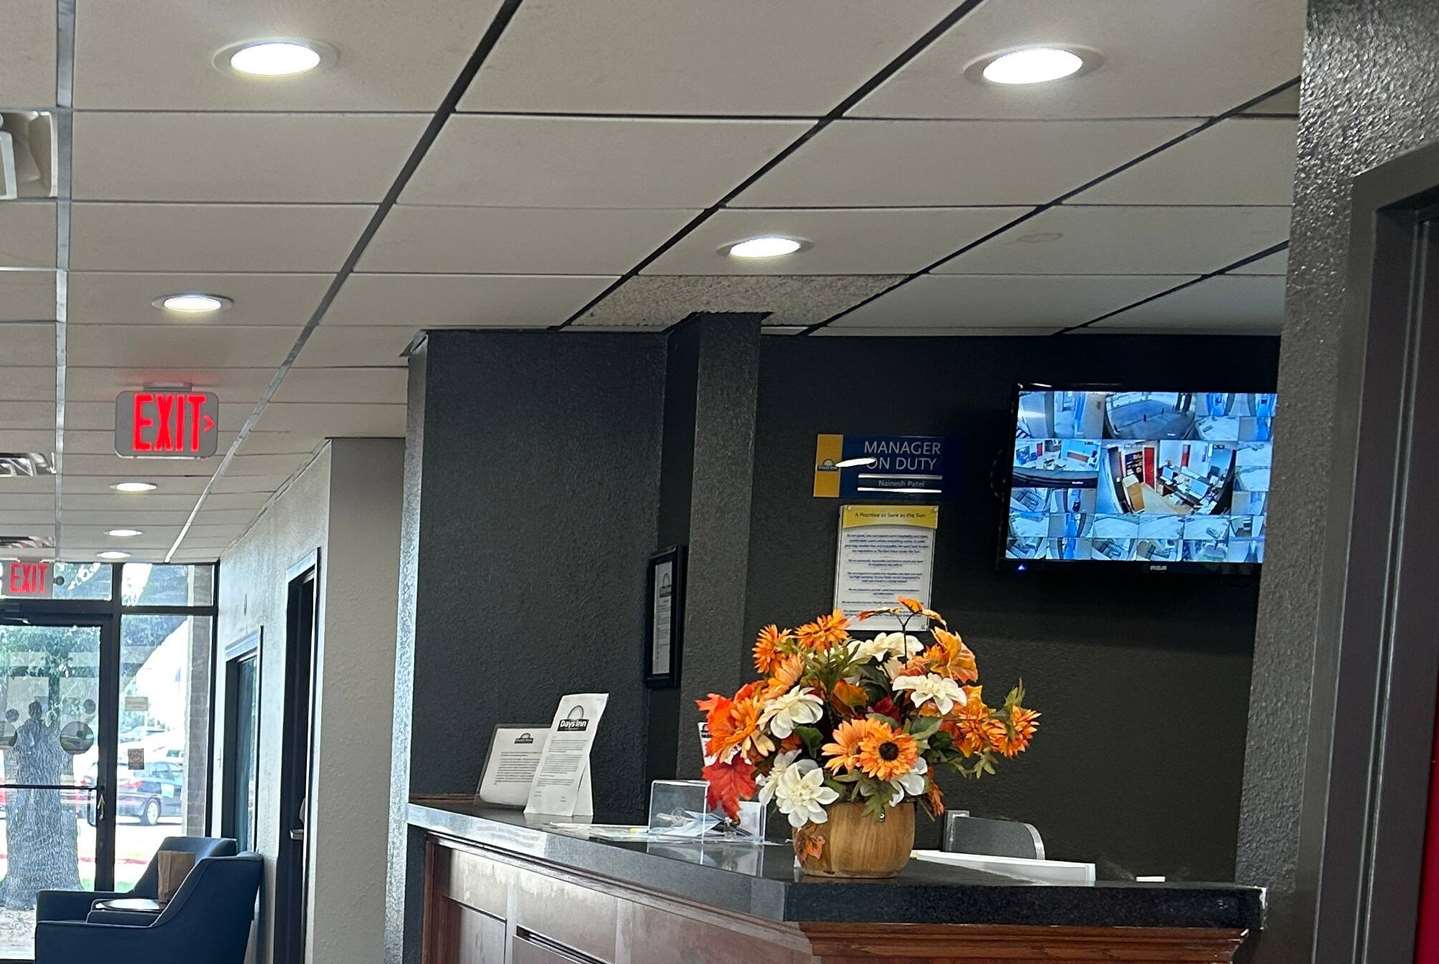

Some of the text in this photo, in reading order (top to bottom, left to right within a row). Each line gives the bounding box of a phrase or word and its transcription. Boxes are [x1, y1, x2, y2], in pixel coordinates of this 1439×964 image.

[133, 392, 207, 452] EXIT
[863, 441, 940, 455] MANAGER
[865, 457, 936, 471] ON DUTY
[9, 563, 48, 593] EXIT
[560, 720, 575, 728] Days
